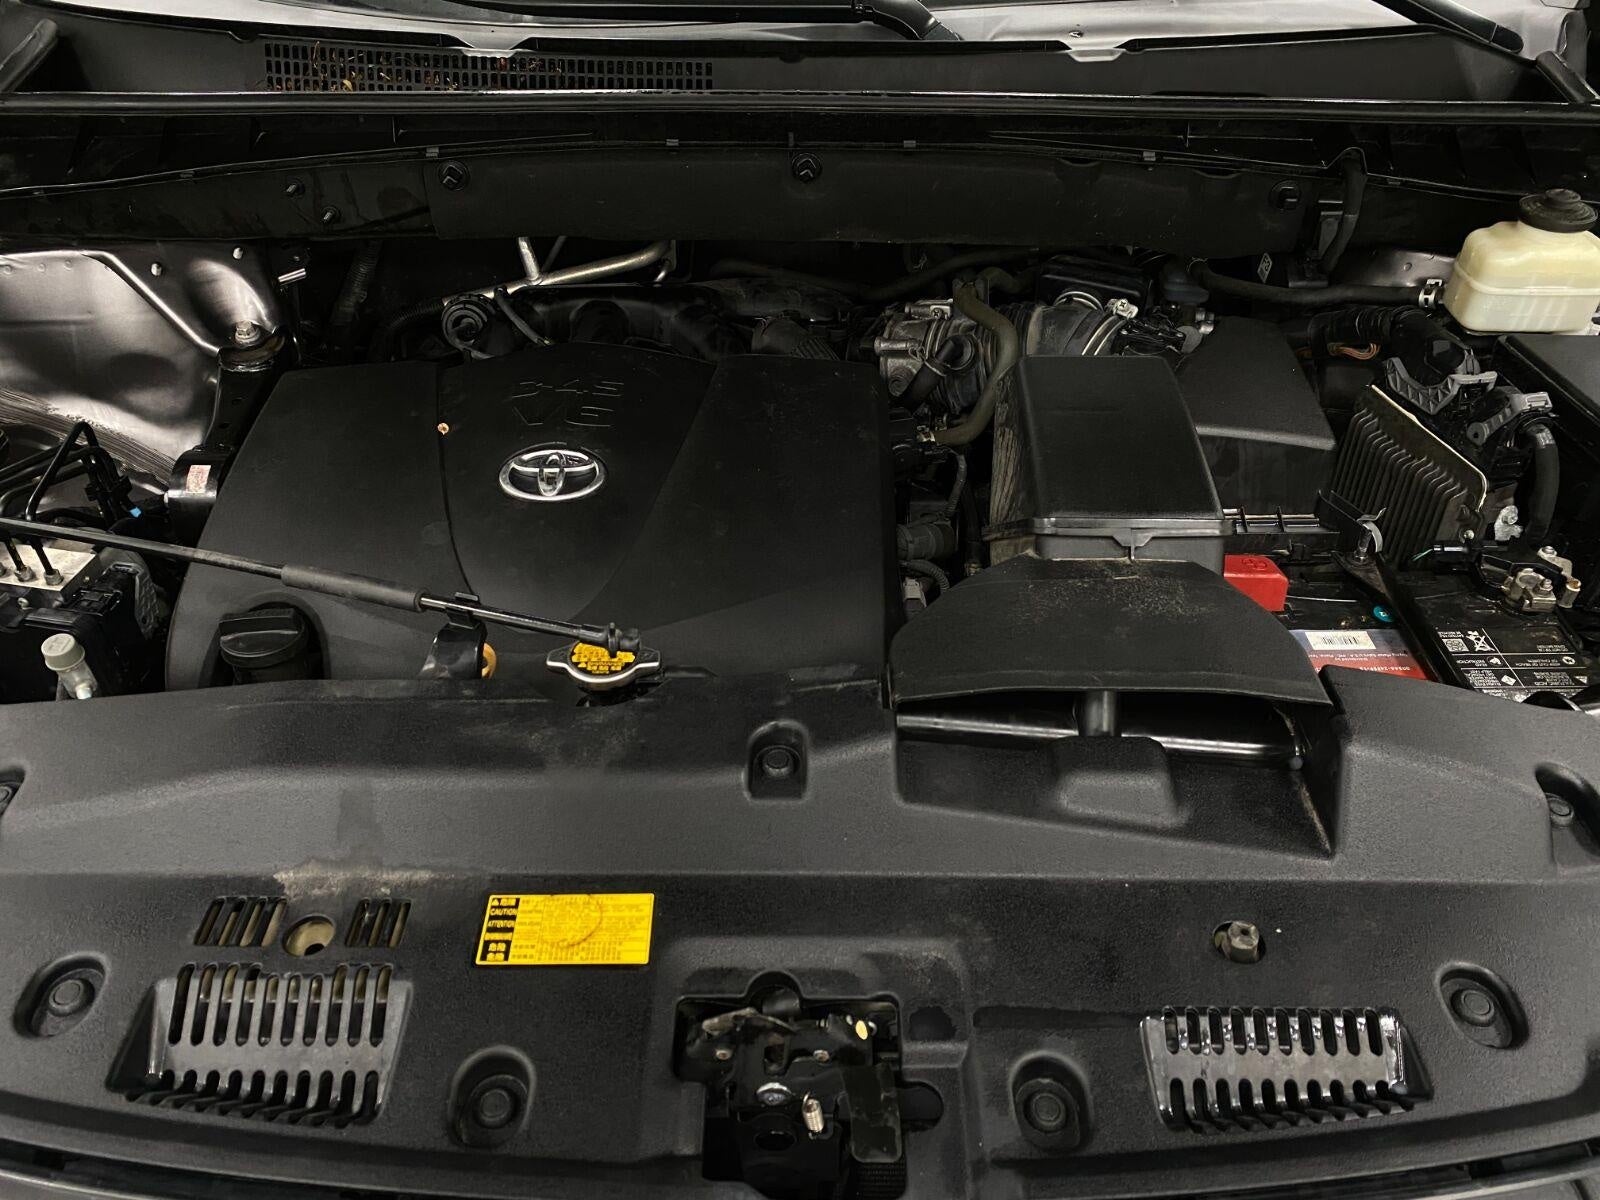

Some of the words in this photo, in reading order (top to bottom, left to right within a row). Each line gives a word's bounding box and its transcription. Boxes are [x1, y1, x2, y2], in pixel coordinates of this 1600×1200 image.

[511, 405, 616, 429] V6
[490, 908, 517, 916] CAUTION
[487, 919, 515, 928] ATTENTION
